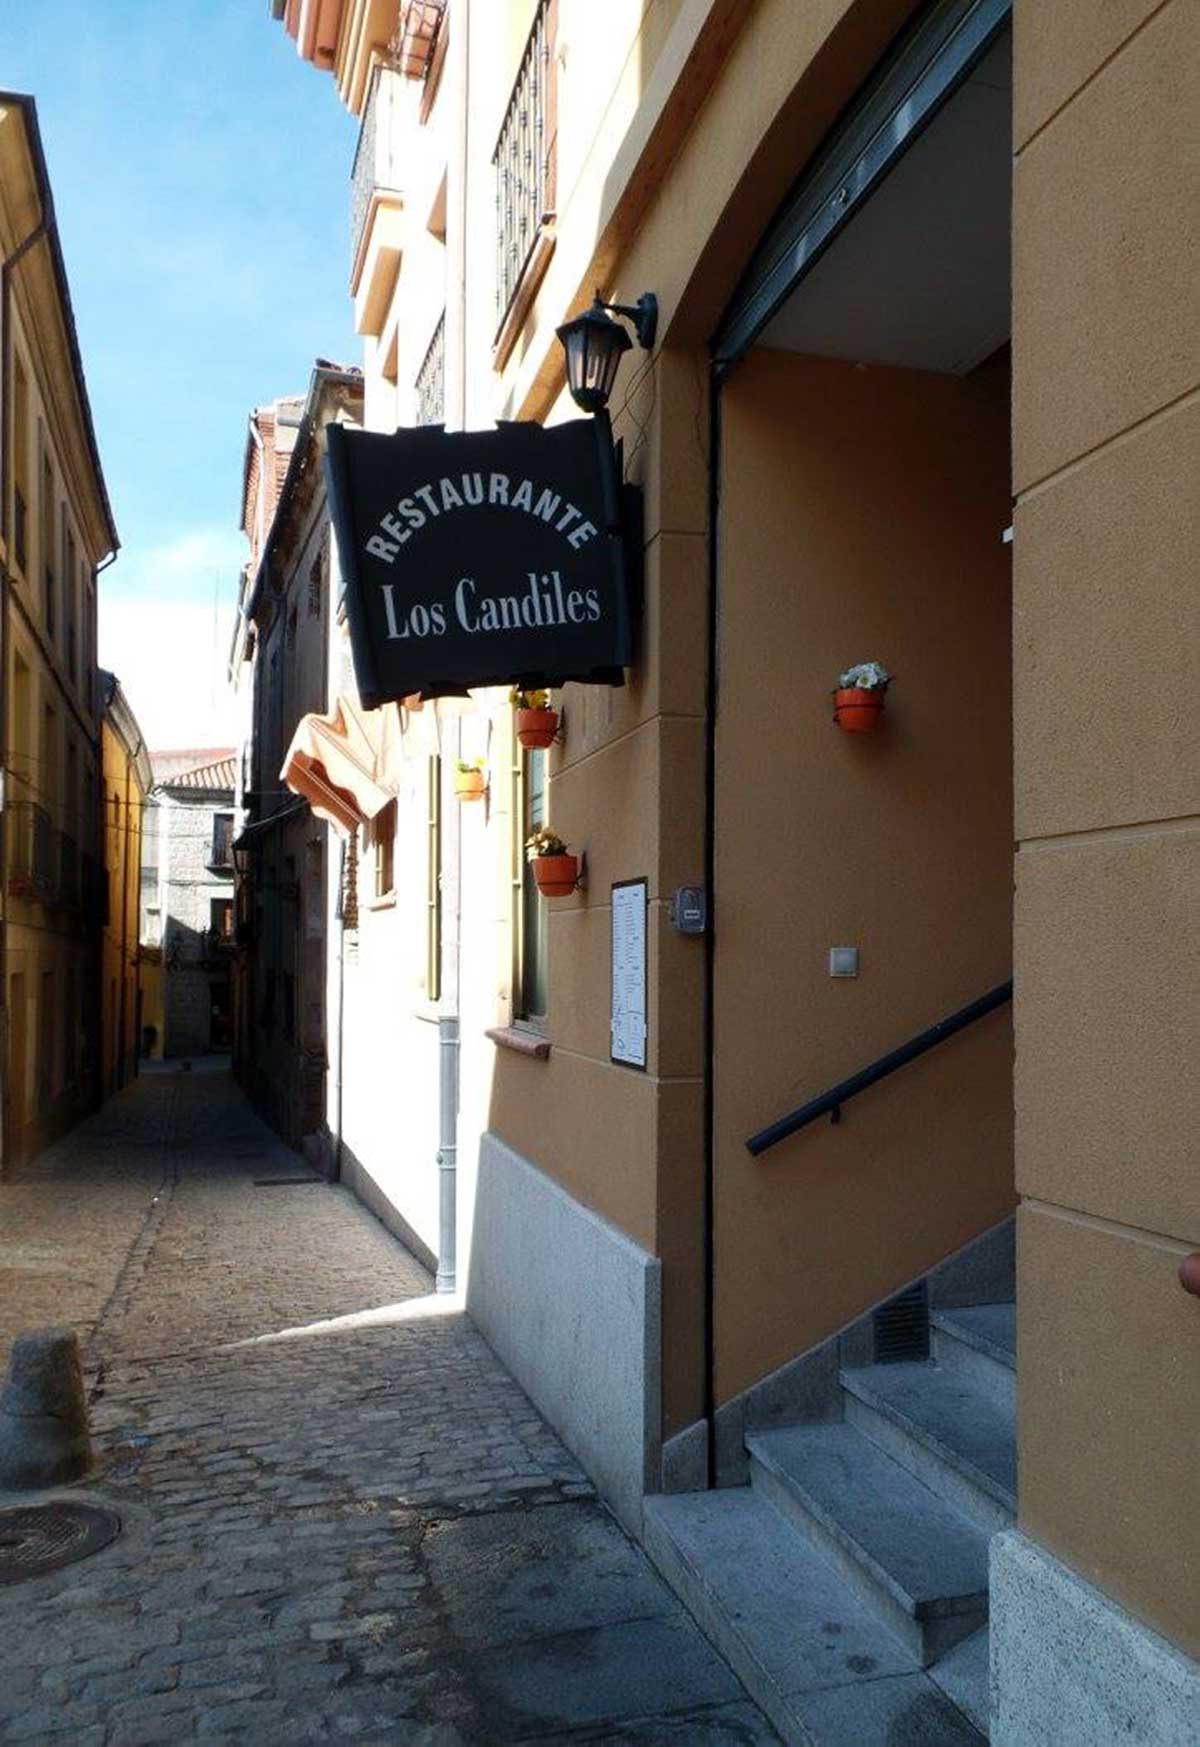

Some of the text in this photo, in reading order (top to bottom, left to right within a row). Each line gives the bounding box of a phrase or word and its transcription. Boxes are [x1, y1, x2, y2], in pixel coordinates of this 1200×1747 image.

[366, 473, 598, 563] RESTAURANTE
[381, 571, 600, 639] Los Candiles
